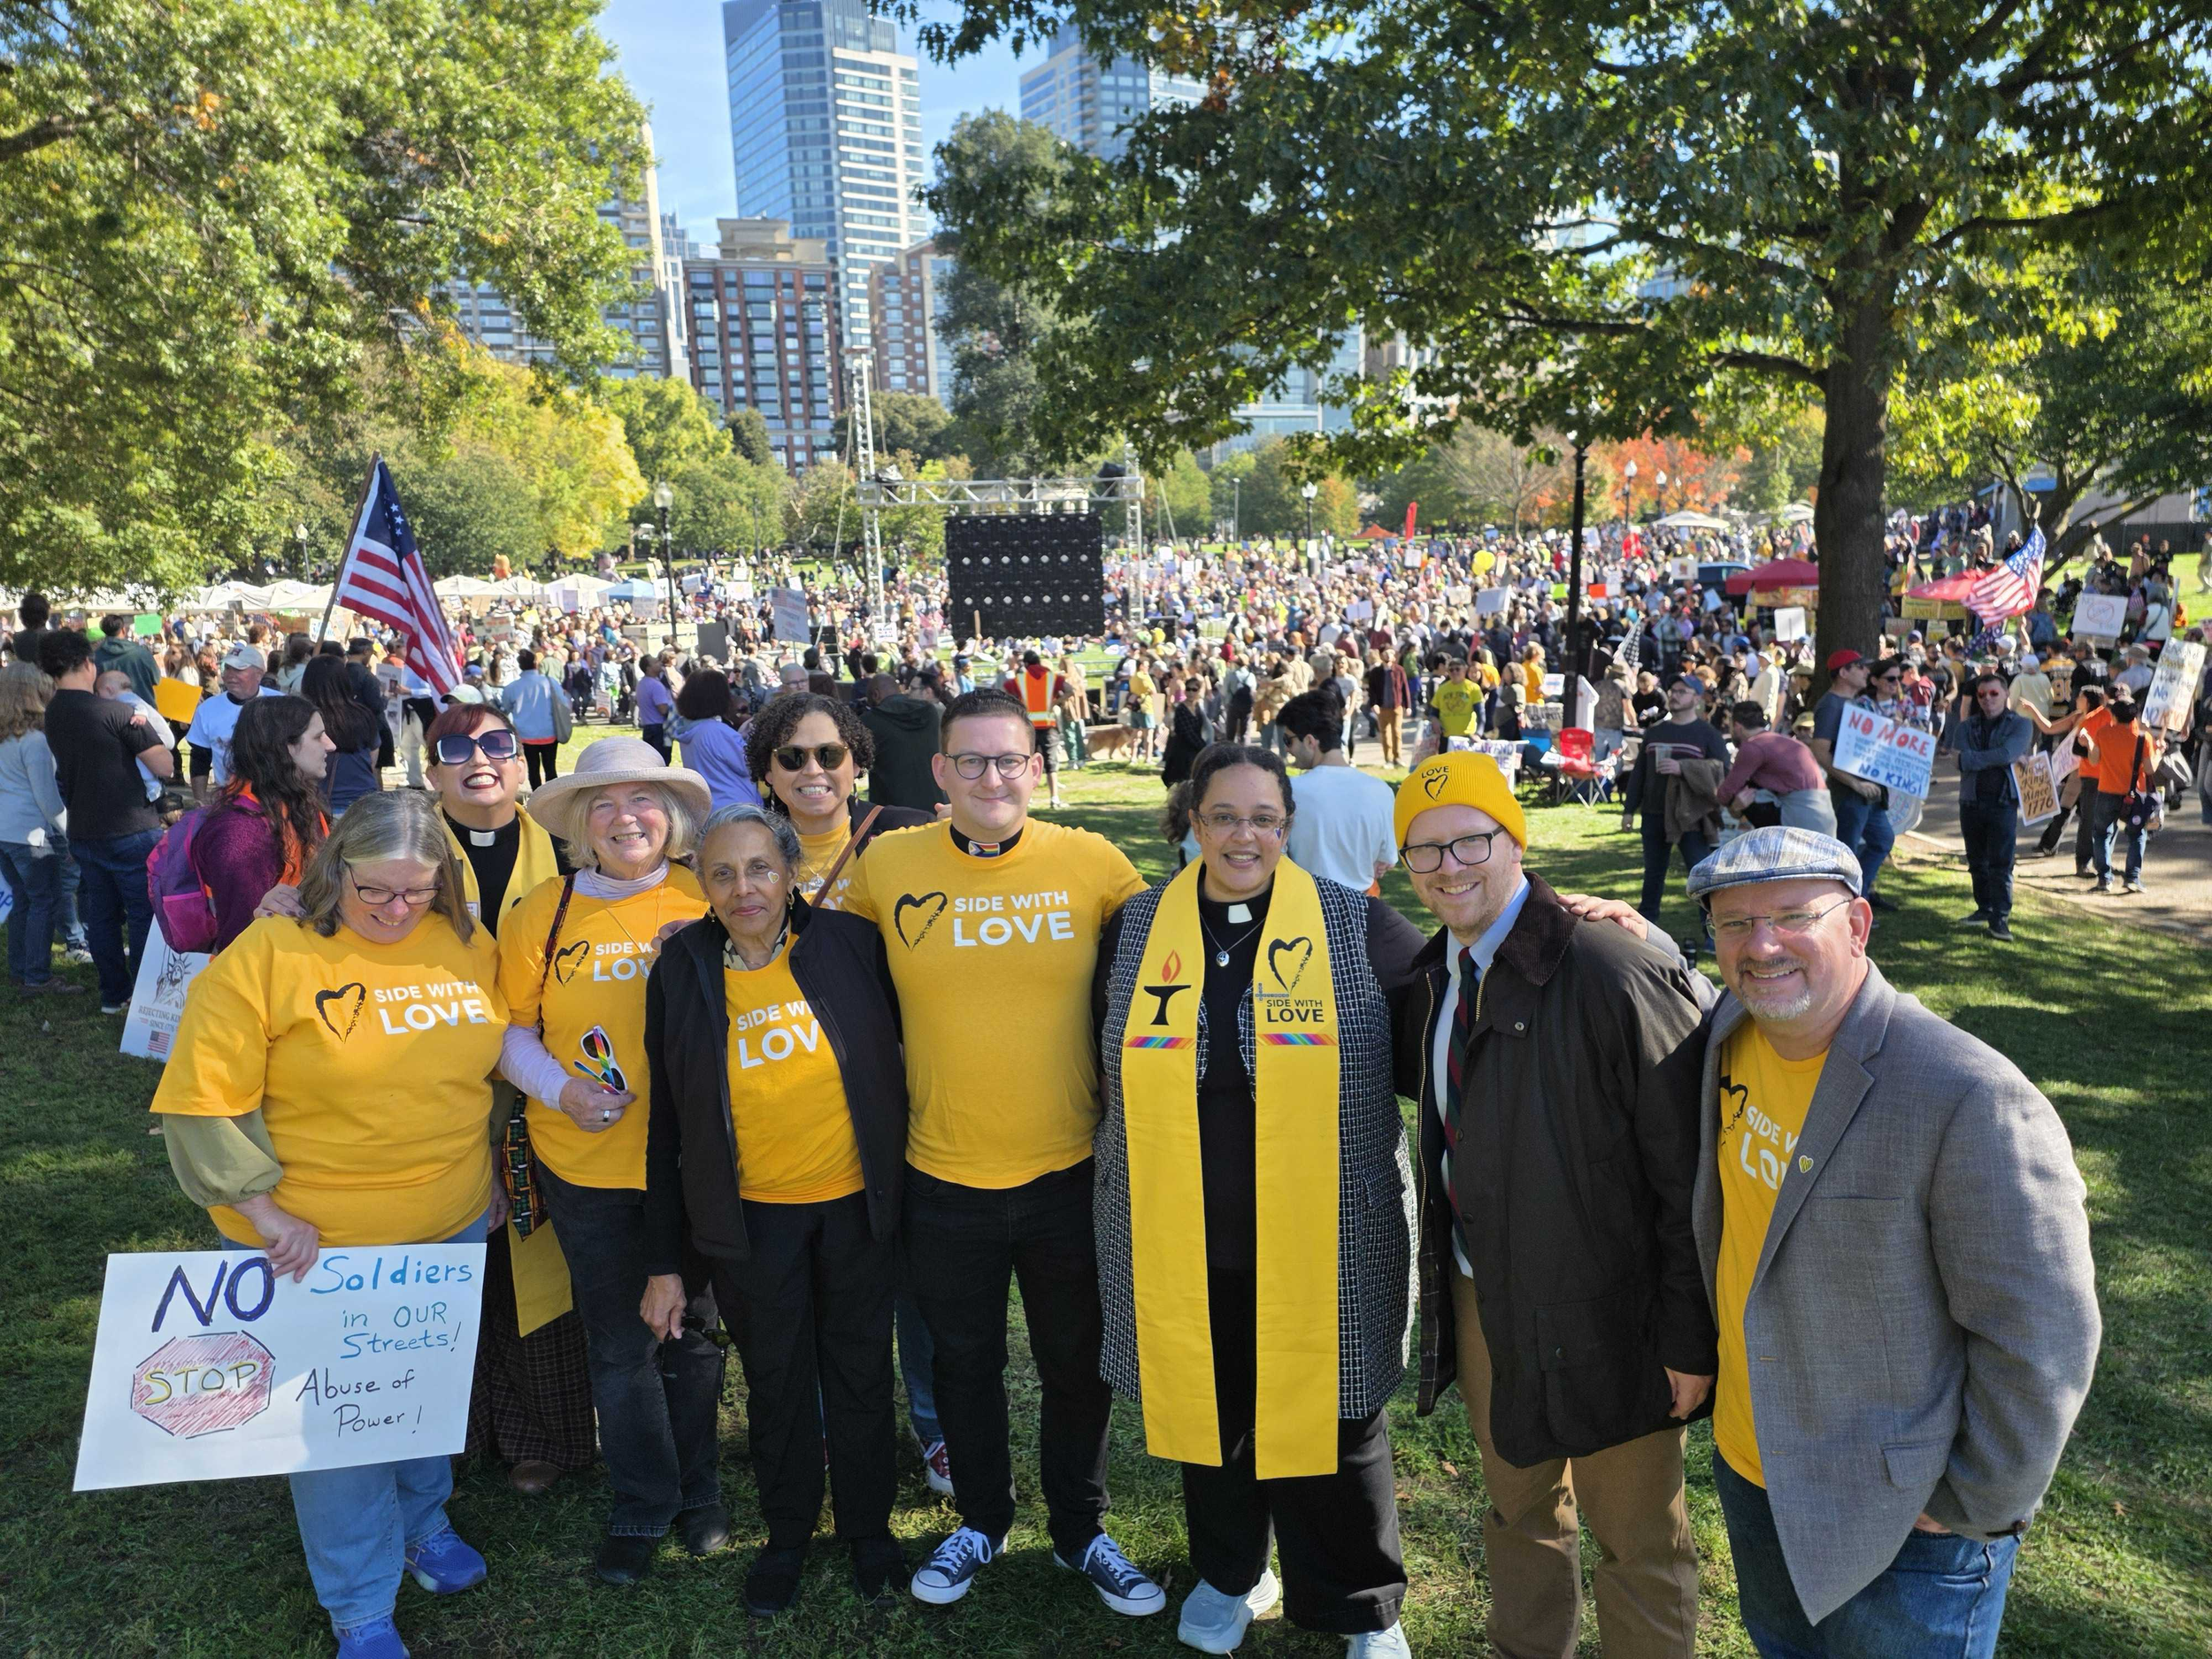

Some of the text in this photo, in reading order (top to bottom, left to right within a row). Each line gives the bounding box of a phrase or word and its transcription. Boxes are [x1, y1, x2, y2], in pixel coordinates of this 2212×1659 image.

[1848, 710, 1874, 735] NO
[1877, 722, 1931, 758] MORE
[1422, 766, 1449, 779] LOVE
[1497, 758, 1510, 769] HE
[1858, 763, 1880, 778] NO
[1885, 772, 1922, 796] KING!
[2028, 797, 2054, 817] 1776
[955, 890, 1069, 912] SIDE WITH
[953, 911, 1074, 947] LOVE
[595, 942, 634, 956] SIDE
[593, 957, 655, 982] LOV
[373, 981, 480, 1003] SIDE WITH
[138, 1005, 170, 1020] REJECTING
[150, 1019, 175, 1033] SINCE 1776
[378, 999, 488, 1035] LOVE
[737, 1004, 780, 1032] SIDE
[1267, 1009, 1325, 1022] LOVE
[738, 1019, 819, 1070] LOV
[1747, 1105, 1781, 1146] SIDE
[1740, 1132, 1787, 1190] LO
[151, 1255, 473, 1333] NO Soldiers
[342, 1301, 448, 1328] in OUR
[340, 1321, 462, 1359] Streets!
[143, 1361, 259, 1405] STOP
[296, 1367, 416, 1407] Abuse of
